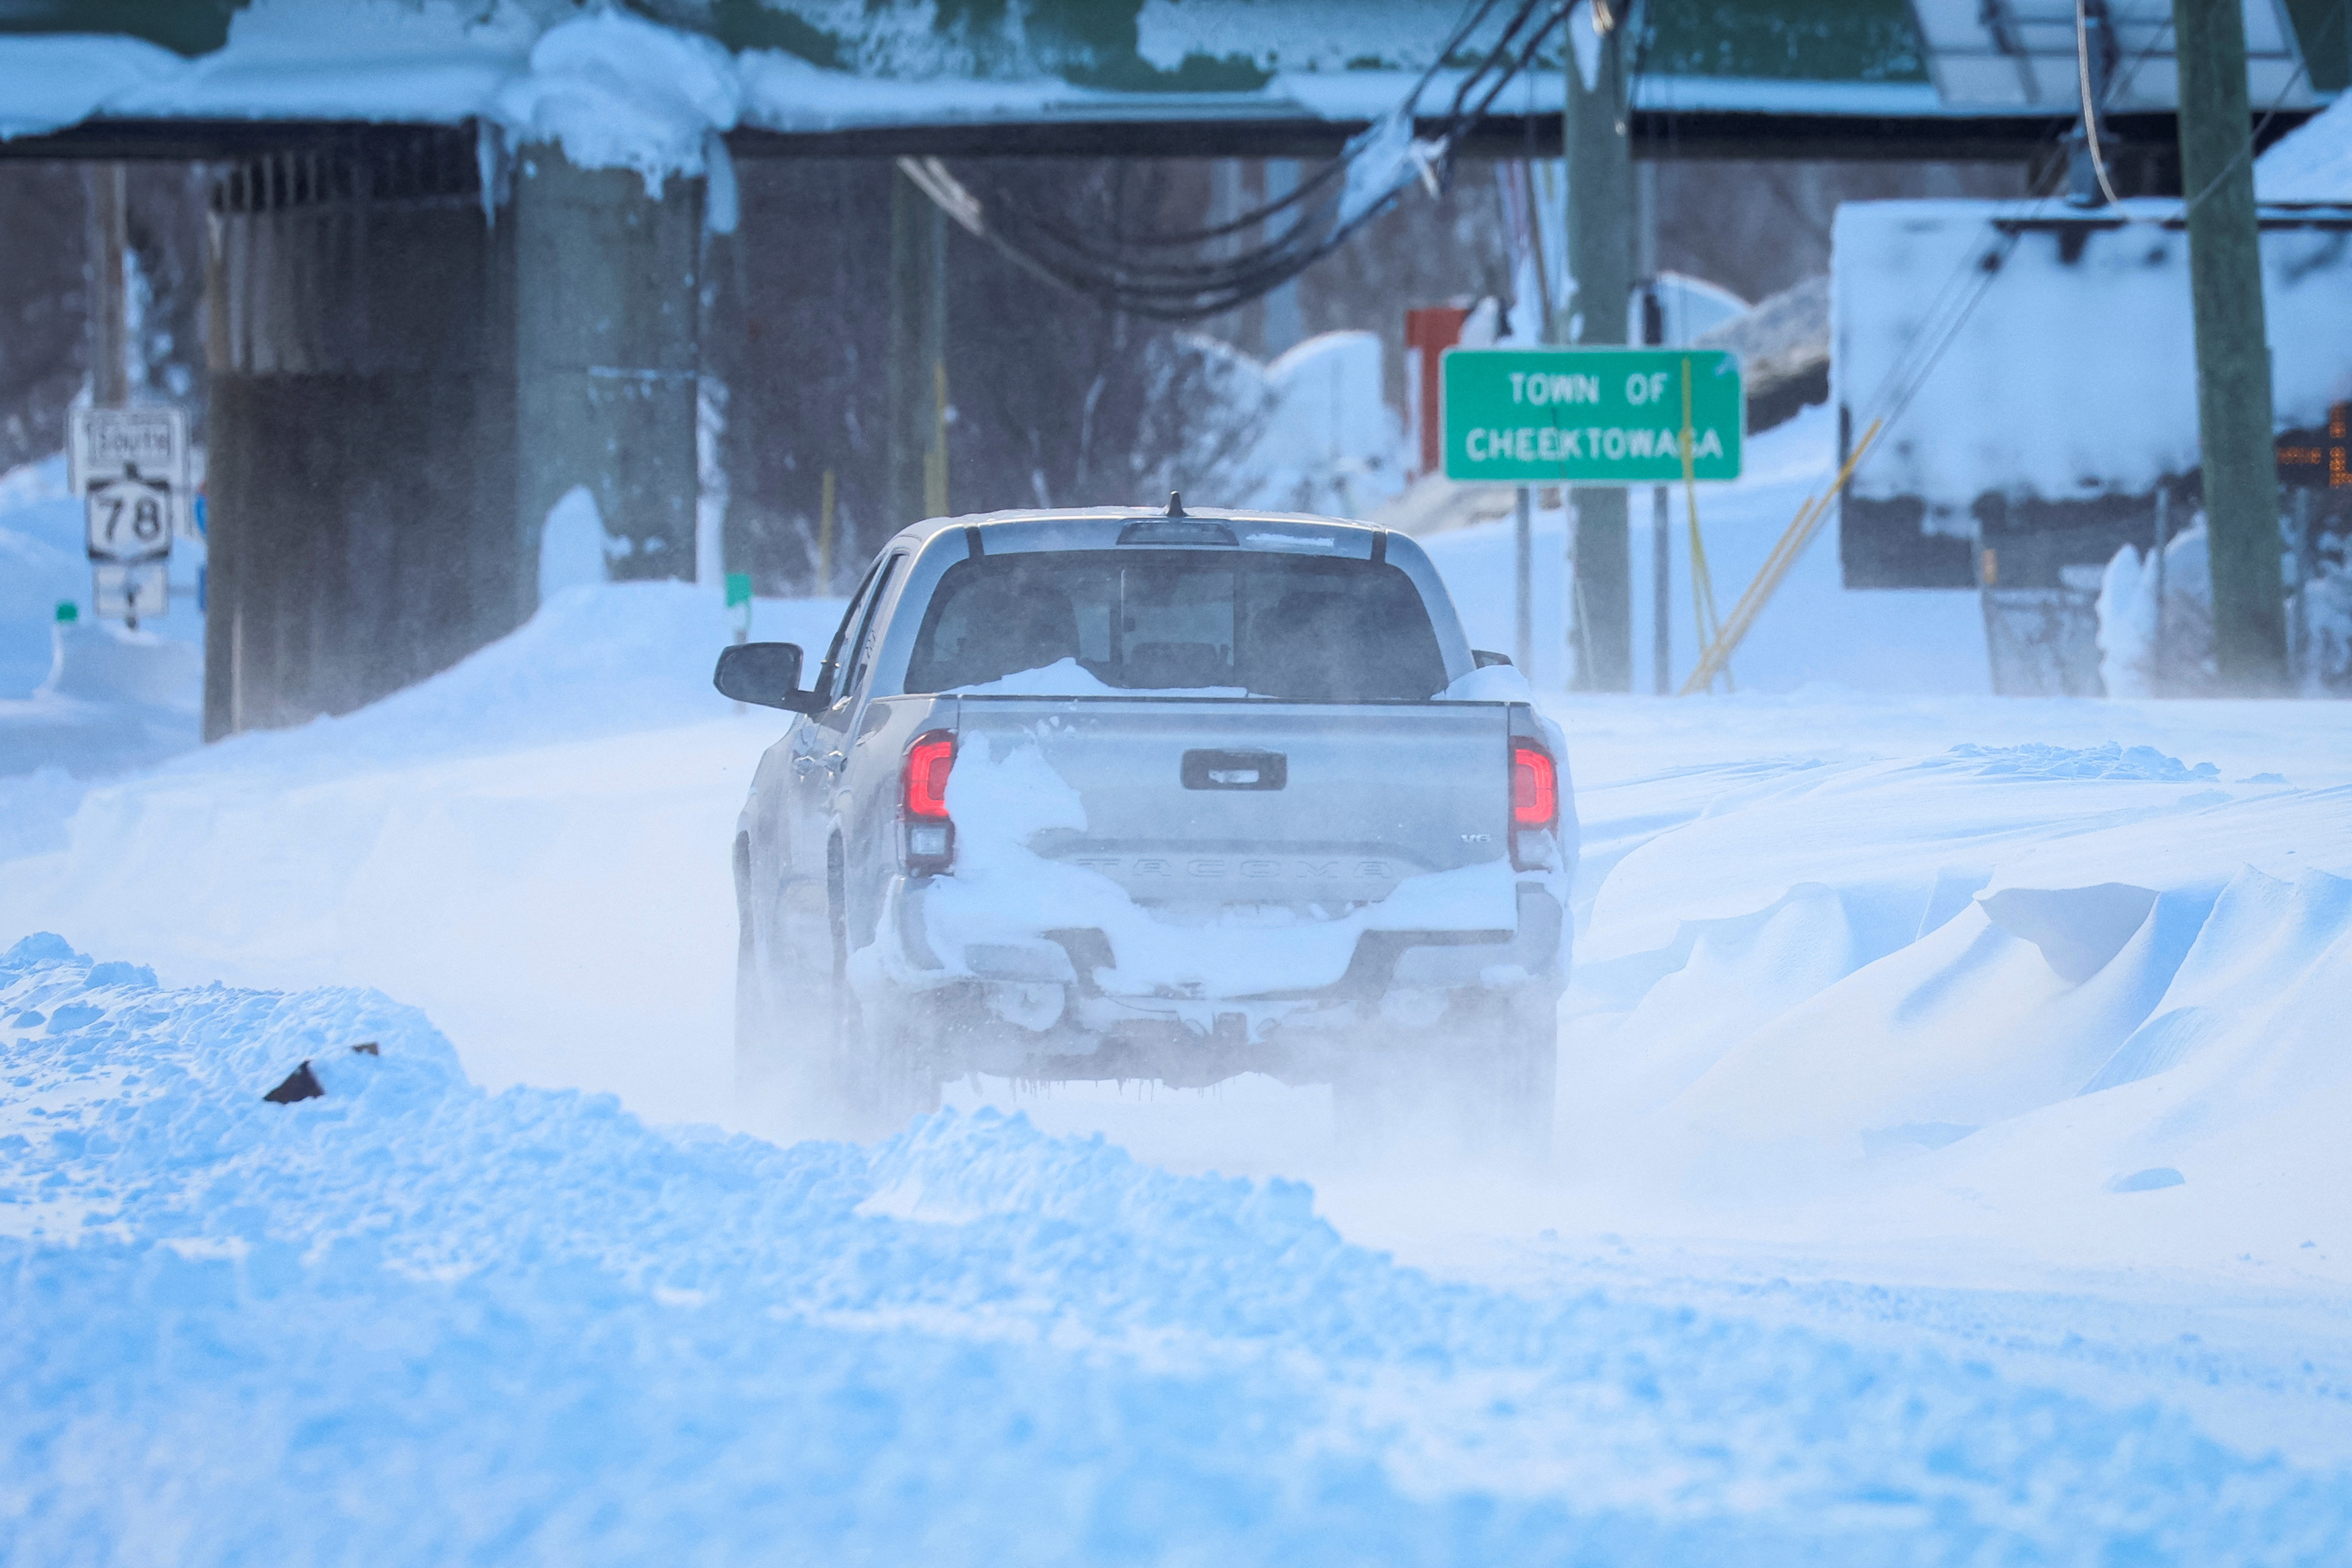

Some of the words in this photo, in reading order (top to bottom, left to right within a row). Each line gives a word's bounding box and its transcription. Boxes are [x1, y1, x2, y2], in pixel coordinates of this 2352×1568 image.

[1509, 373, 1600, 405] TOWN
[1625, 373, 1668, 405] OF
[1465, 426, 1724, 462] CHEEKTOWAGA
[99, 496, 160, 541] 78
[1461, 833, 1491, 843] V6
[1077, 857, 1392, 879] TACOMA
